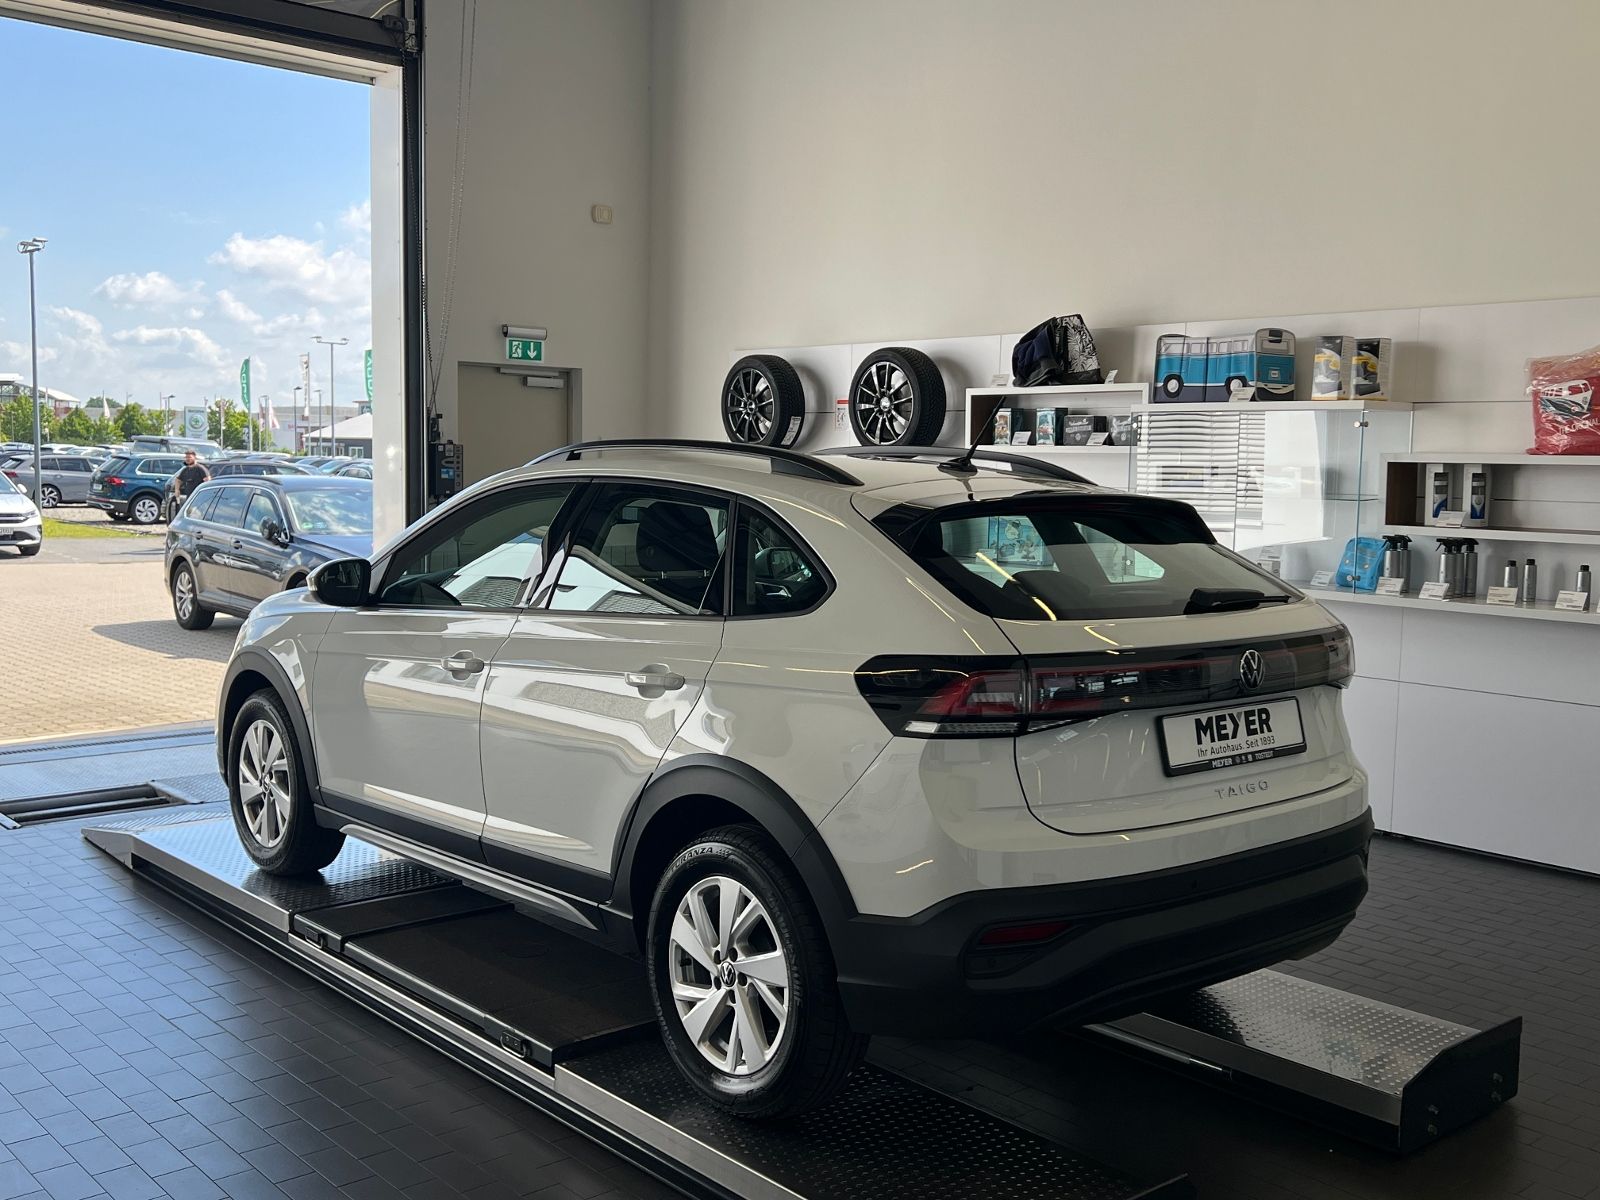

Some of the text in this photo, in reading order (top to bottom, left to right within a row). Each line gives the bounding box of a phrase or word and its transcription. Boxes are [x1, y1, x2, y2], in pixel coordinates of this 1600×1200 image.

[1195, 708, 1272, 745] MEYER
[1198, 735, 1276, 758] Ihr Autohaus. Seit 1893
[1212, 757, 1233, 769] MEYER
[1214, 780, 1268, 799] TAIGO
